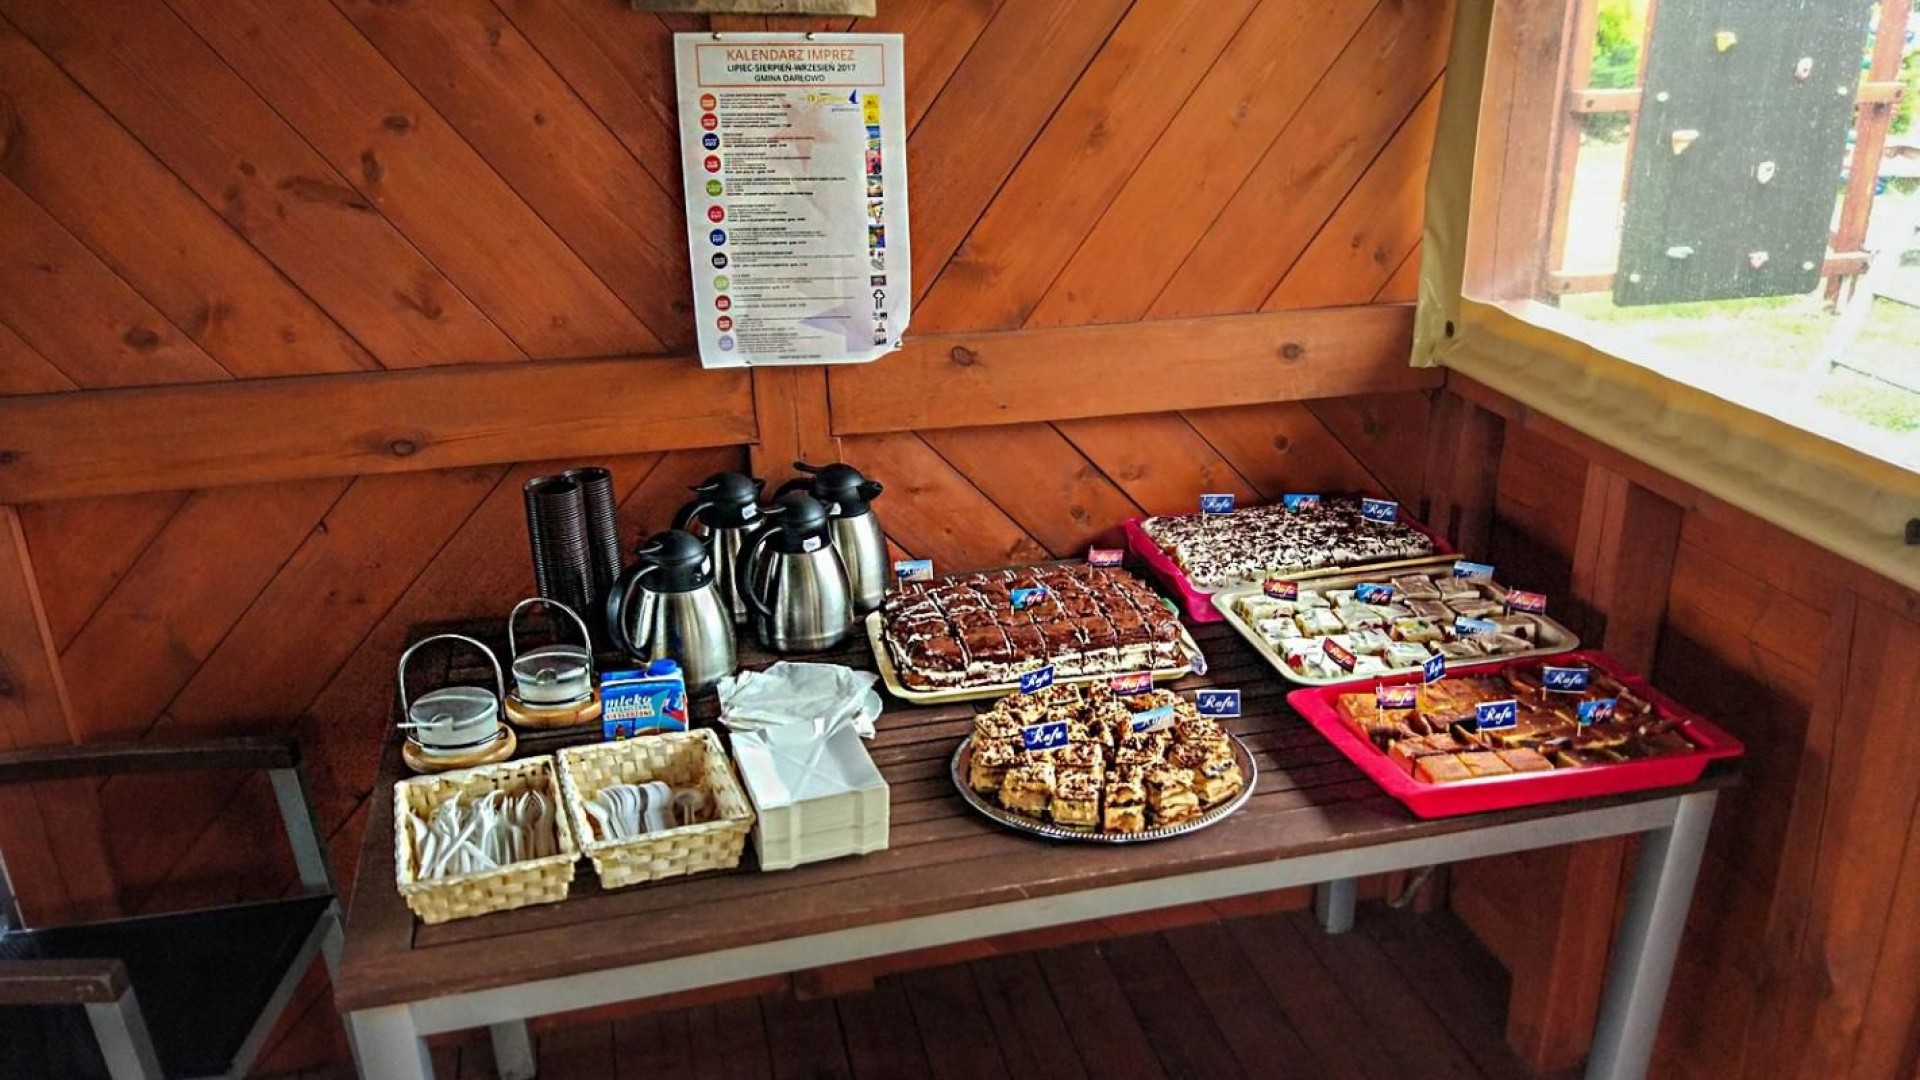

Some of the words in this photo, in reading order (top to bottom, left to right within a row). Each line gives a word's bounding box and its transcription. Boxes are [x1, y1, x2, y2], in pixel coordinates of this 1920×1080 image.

[726, 49, 804, 61] KALENDARZ
[808, 49, 855, 61] IMPREZ
[836, 63, 856, 72] 2017
[754, 74, 781, 82] GMINA
[783, 73, 826, 82] DARŁOWO
[1365, 503, 1393, 518] Rafa
[1552, 671, 1583, 688] Rafa
[605, 694, 651, 708] mleko
[1206, 694, 1235, 713] Rafa
[1484, 707, 1512, 724] Rafa
[1032, 726, 1064, 747] Rafa
